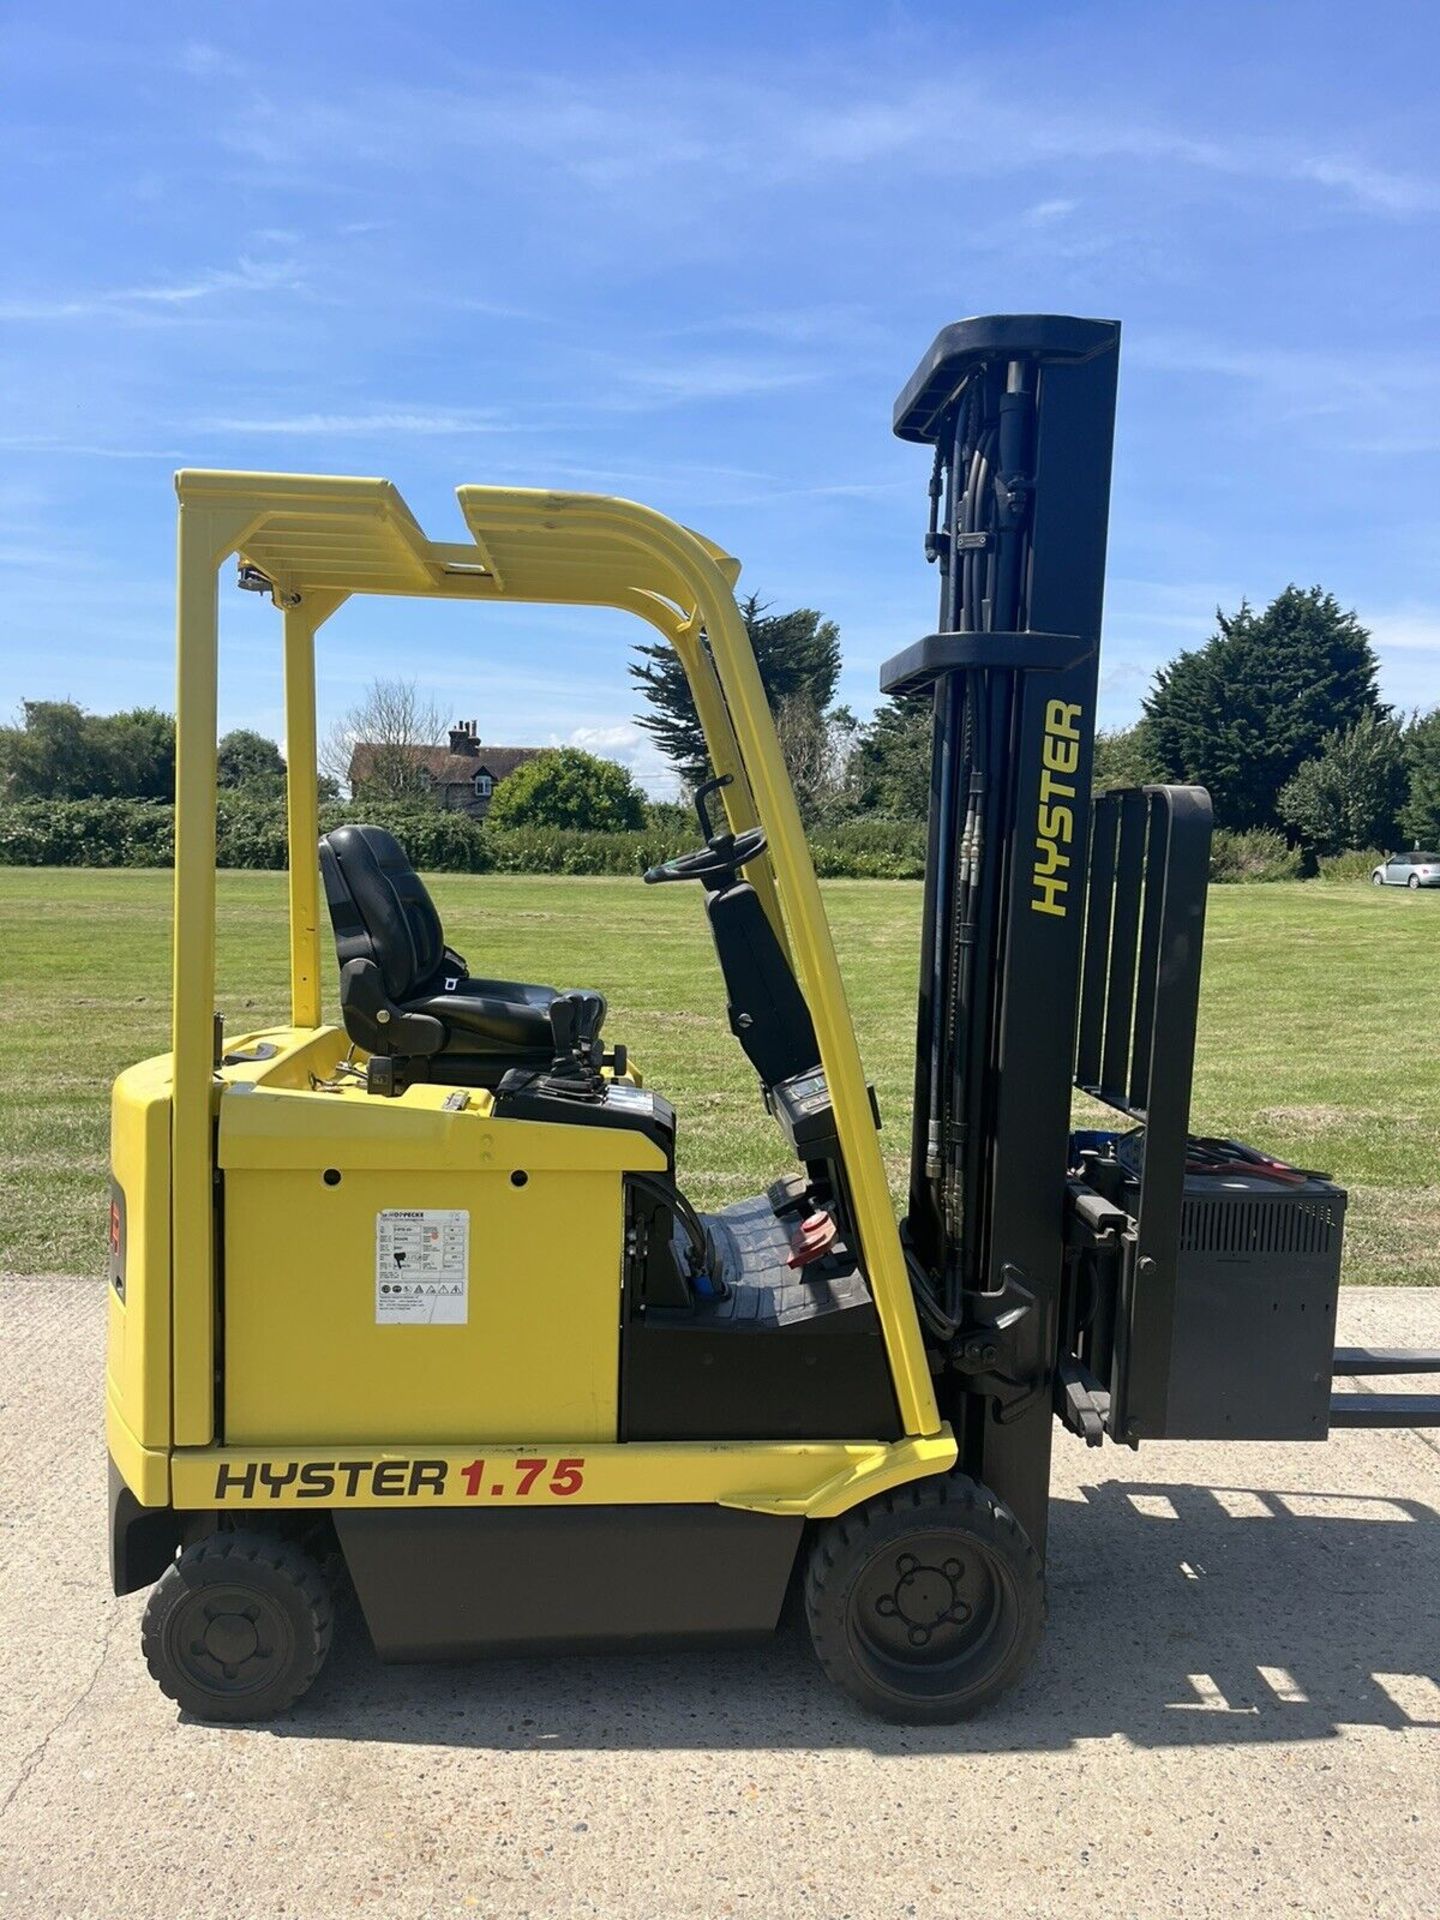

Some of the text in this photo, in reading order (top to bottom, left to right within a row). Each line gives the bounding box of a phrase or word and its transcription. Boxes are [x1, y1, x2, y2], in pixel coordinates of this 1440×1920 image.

[1032, 699, 1082, 917] HYSTER
[214, 1458, 585, 1499] HYSTER 1.75
